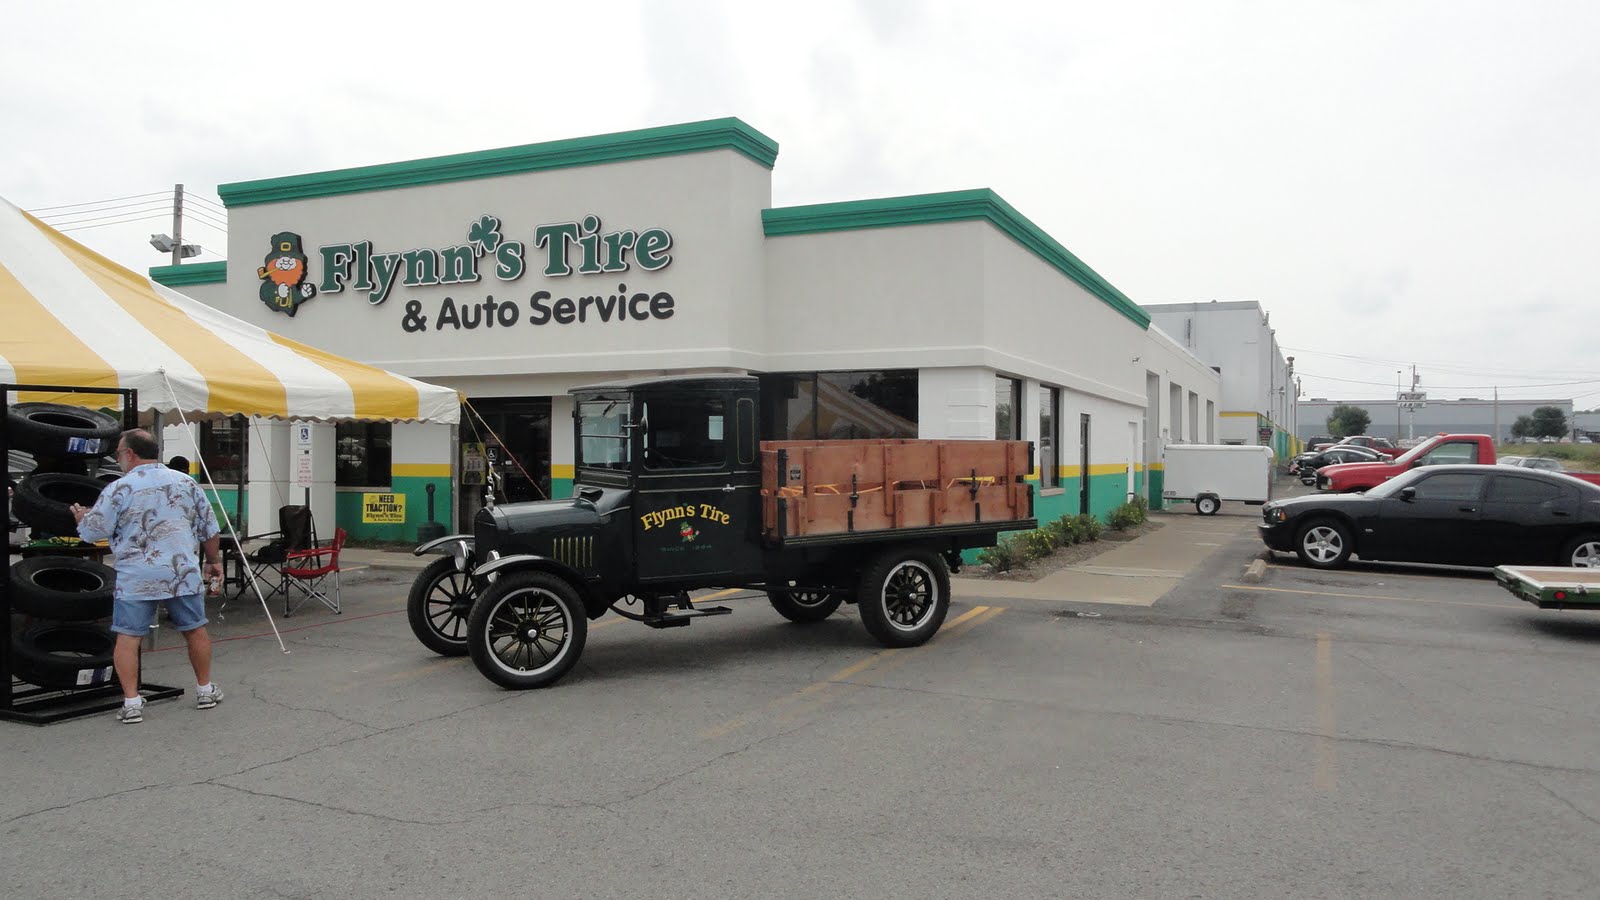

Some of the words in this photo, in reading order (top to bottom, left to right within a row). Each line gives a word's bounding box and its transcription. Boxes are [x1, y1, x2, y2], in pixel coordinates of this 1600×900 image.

[318, 213, 526, 306] Flynn's
[533, 214, 673, 277] Tire
[402, 299, 427, 333] &
[436, 295, 519, 330] Auto
[529, 283, 675, 324] Service
[366, 503, 403, 513] TRACTION?
[379, 495, 394, 503] NEED
[640, 503, 696, 531] Flynn's
[700, 503, 730, 525] Tire
